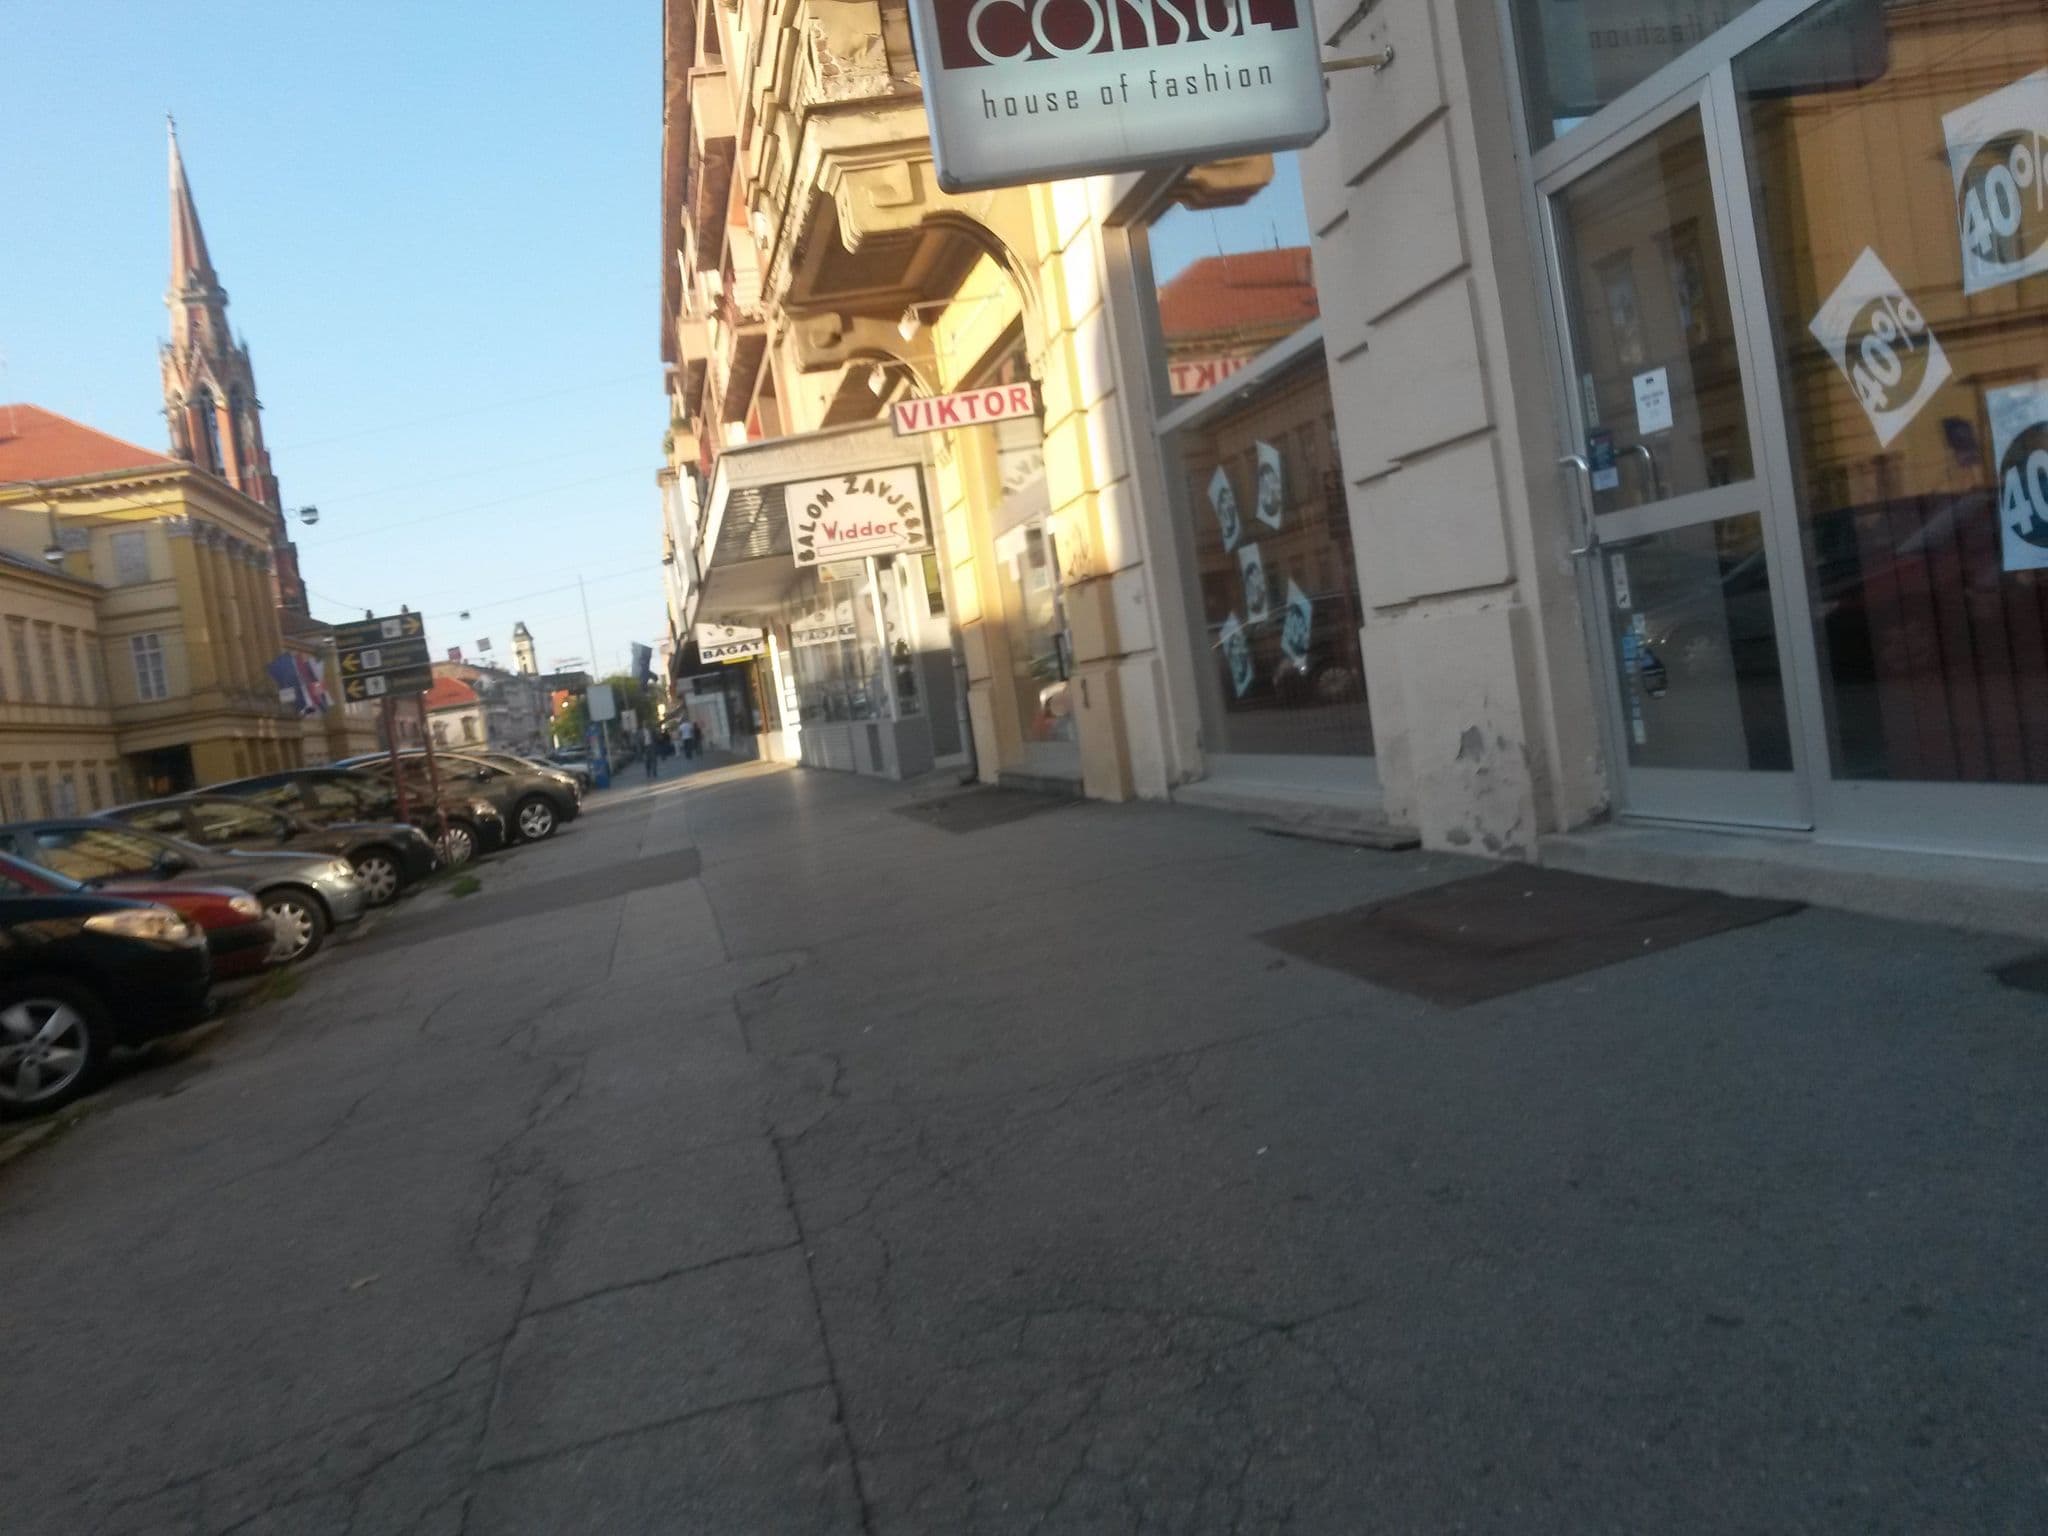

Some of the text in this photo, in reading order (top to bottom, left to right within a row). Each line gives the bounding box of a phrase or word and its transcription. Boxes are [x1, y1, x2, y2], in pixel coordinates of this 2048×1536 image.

[981, 64, 1272, 119] house of fashion
[1852, 296, 1924, 411] 40%
[898, 388, 1029, 429] VIKTOR
[797, 488, 834, 562] BALON
[702, 640, 762, 660] BAGAT
